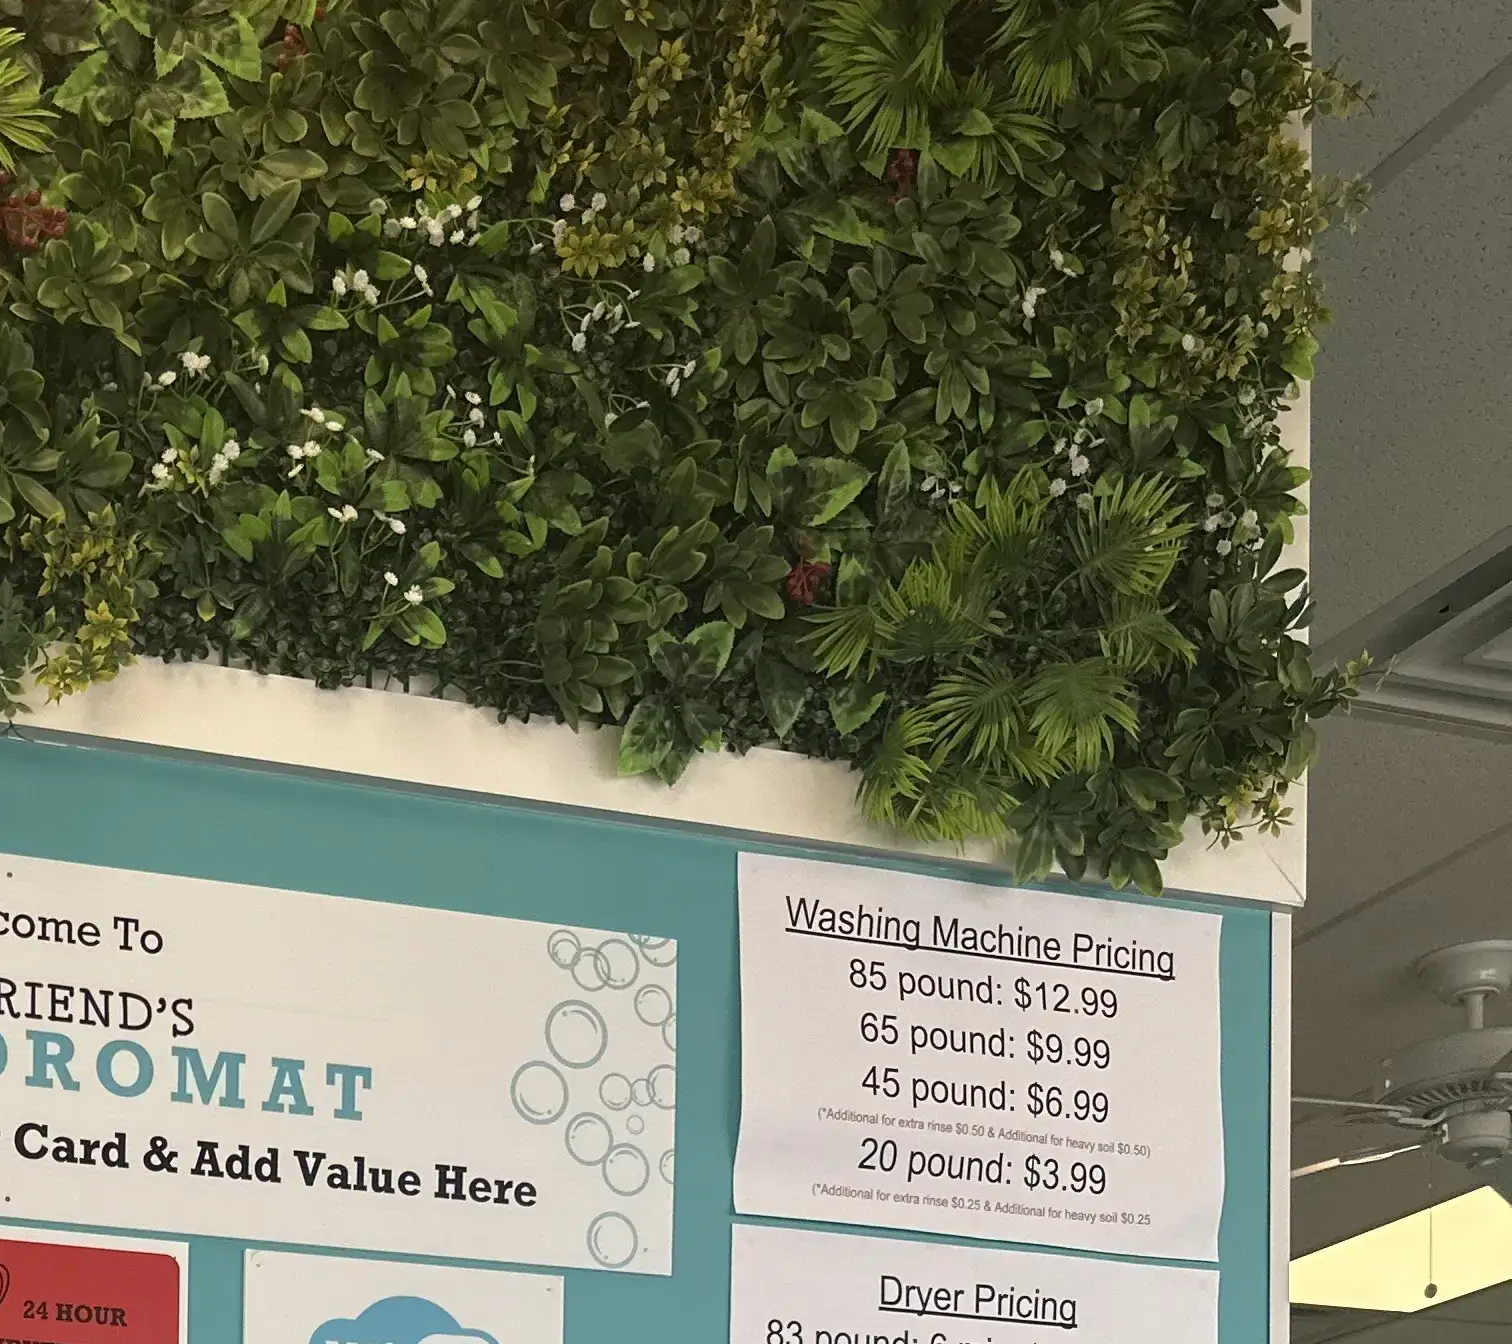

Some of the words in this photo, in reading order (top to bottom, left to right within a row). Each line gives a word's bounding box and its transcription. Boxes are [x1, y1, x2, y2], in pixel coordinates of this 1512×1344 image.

[113, 916, 164, 955] To
[786, 896, 920, 949] Washing
[932, 916, 1060, 961] Machine
[1073, 934, 1175, 980] Pricing
[849, 958, 887, 991] 85
[898, 971, 1003, 1006] pound:
[1014, 976, 1118, 1019] $12.99
[13, 1122, 130, 1169] Card
[142, 1135, 179, 1174] &
[190, 1140, 282, 1184] Add
[292, 1149, 422, 1197] Value
[433, 1163, 537, 1208] Here
[23, 1299, 49, 1320] 24
[55, 1302, 128, 1328] HOUR
[879, 1276, 964, 1315] Dryer
[975, 1284, 1078, 1328] Pricing
